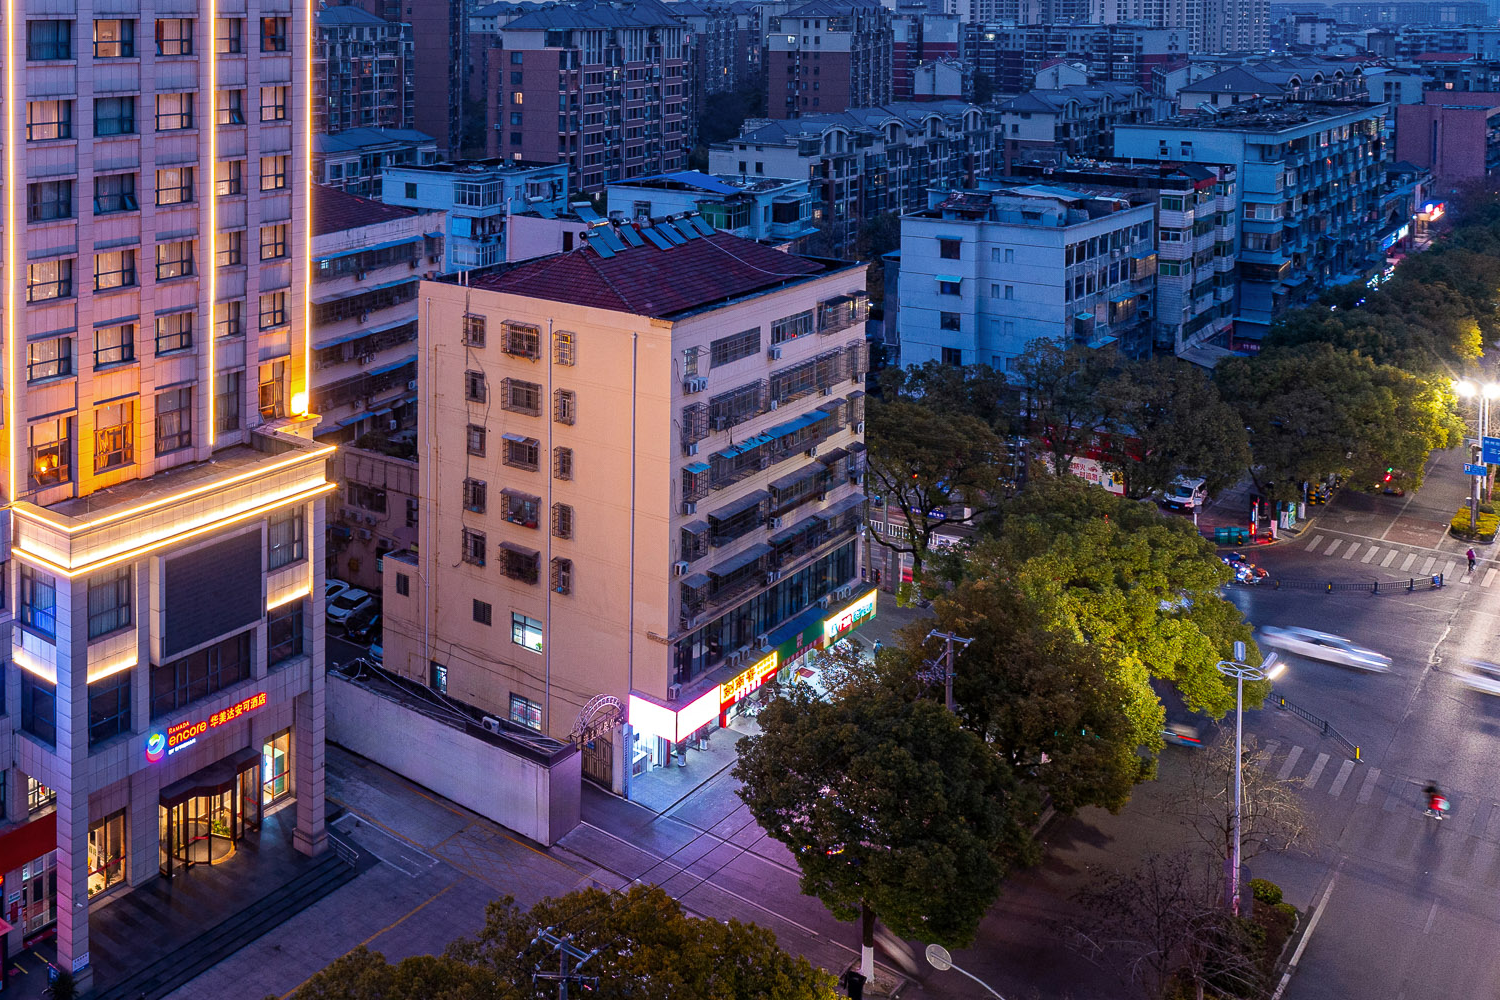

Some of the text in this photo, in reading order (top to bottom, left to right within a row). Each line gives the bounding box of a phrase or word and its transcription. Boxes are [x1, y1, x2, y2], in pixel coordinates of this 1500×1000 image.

[209, 692, 267, 729] 华美达安可酒店
[168, 721, 207, 747] encore
